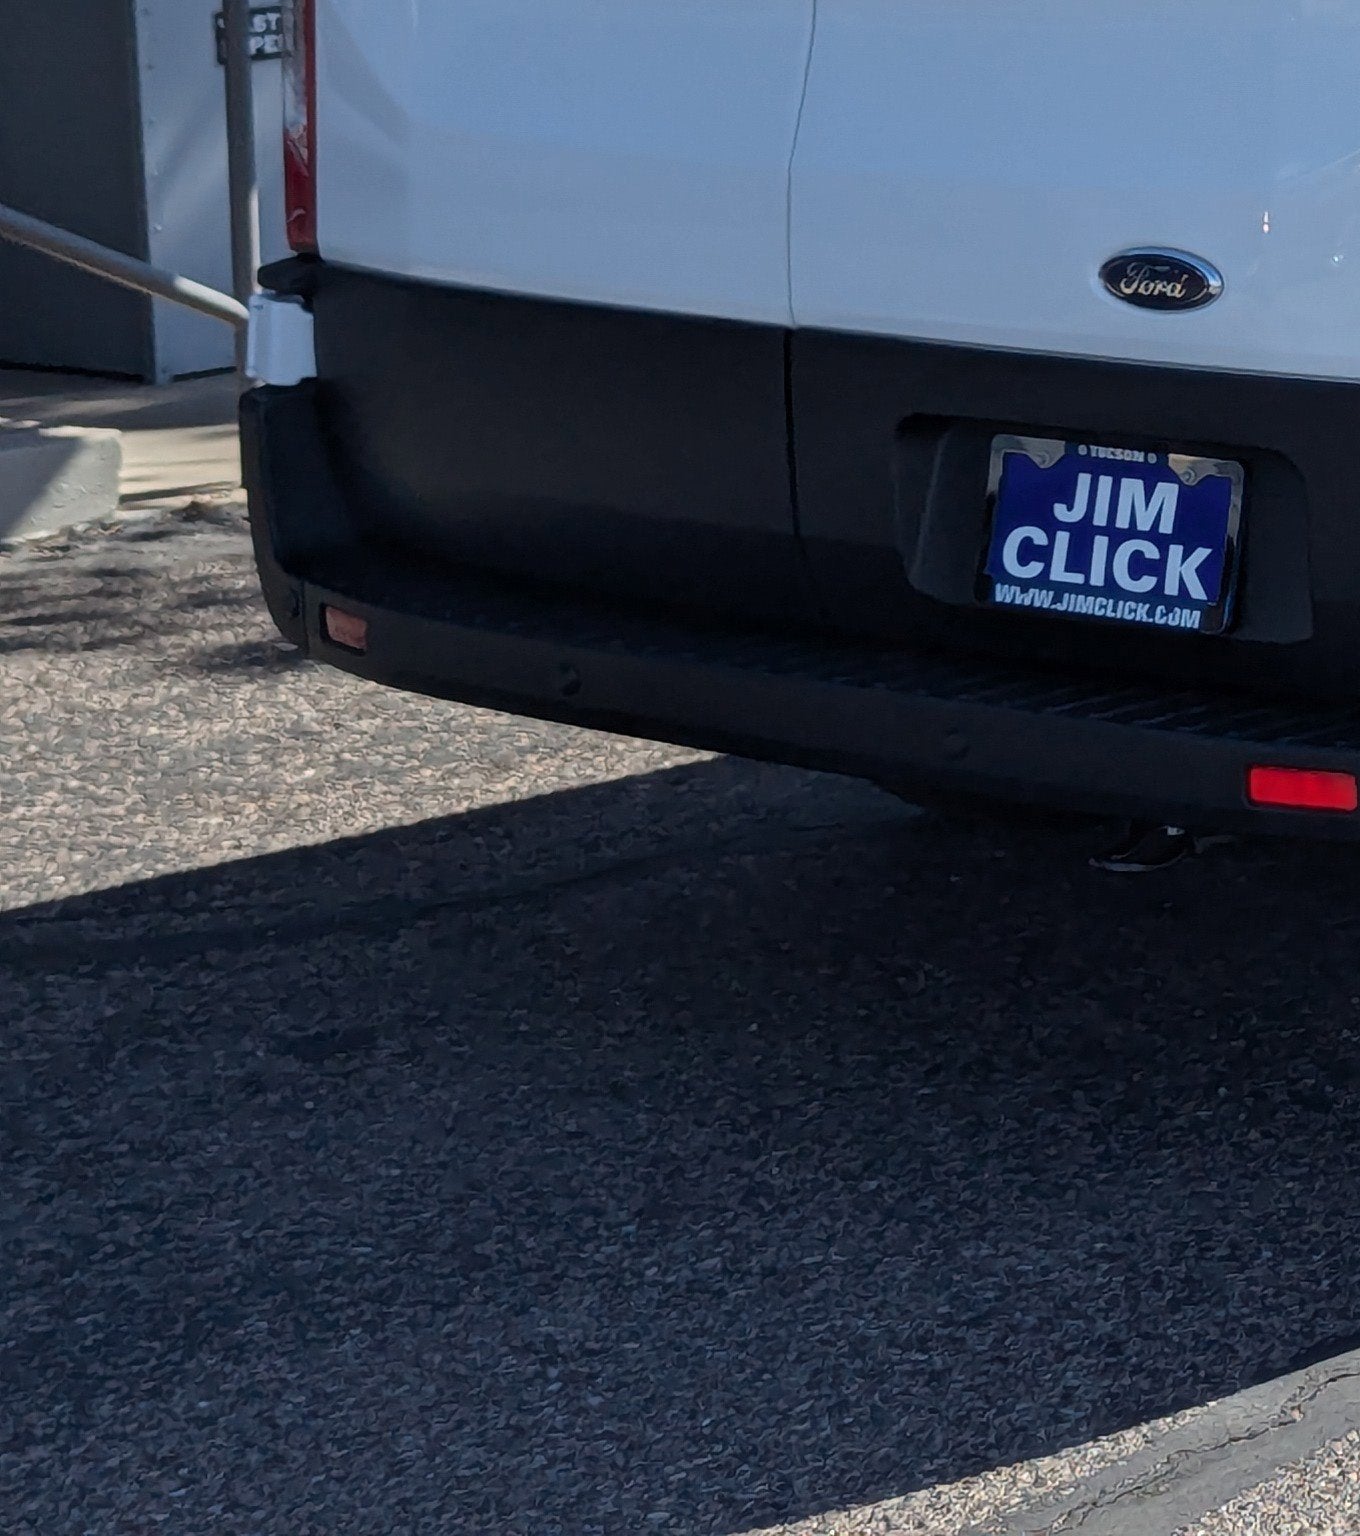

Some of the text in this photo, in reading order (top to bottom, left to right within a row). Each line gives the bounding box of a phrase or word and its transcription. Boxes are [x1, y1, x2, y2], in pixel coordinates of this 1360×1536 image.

[1120, 261, 1189, 298] Ford
[1053, 472, 1180, 534] JIM
[1002, 526, 1212, 601] CLICK
[995, 582, 1201, 629] WWW.JIMCLICK.COM
